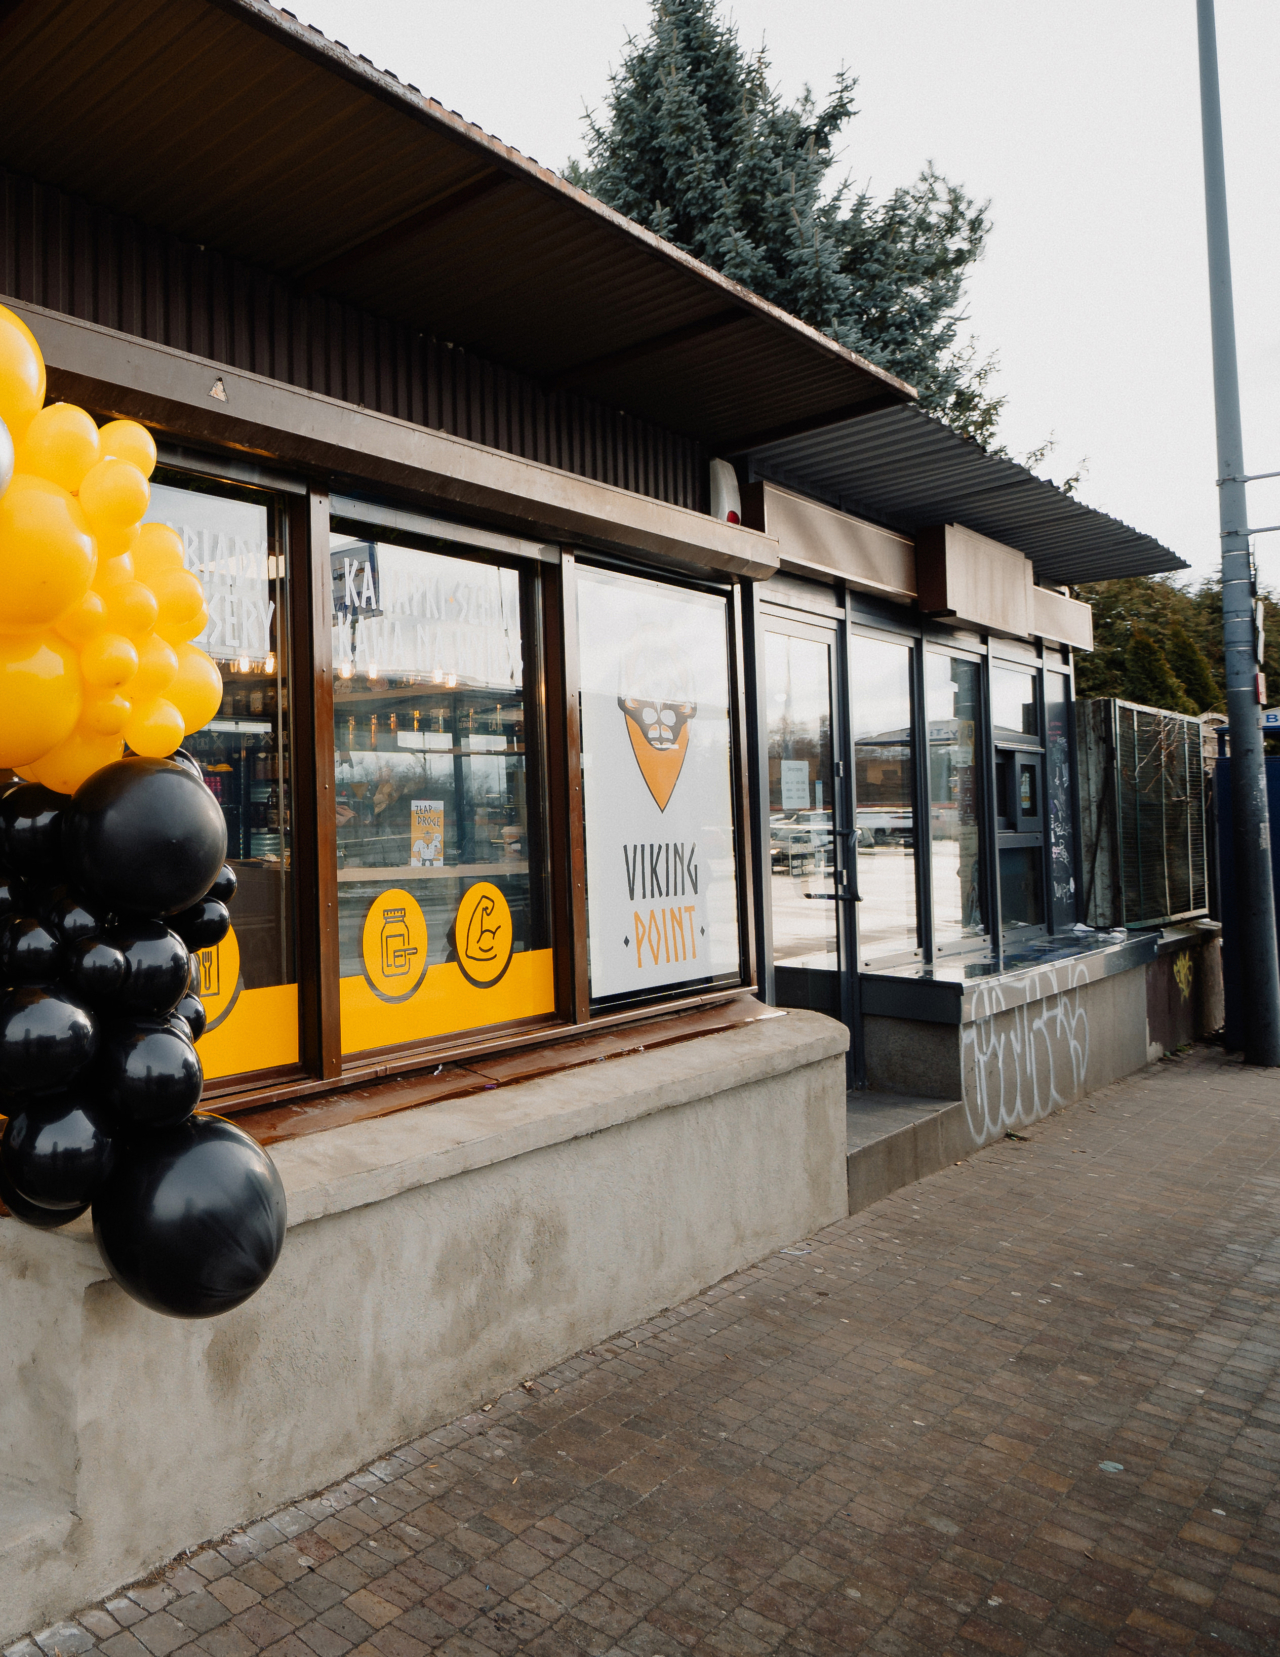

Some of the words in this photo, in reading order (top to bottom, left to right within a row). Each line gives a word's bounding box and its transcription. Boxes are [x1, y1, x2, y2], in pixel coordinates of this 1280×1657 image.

[166, 521, 268, 592] BIADY
[623, 841, 698, 900] VIKING
[634, 905, 697, 968] POINT
